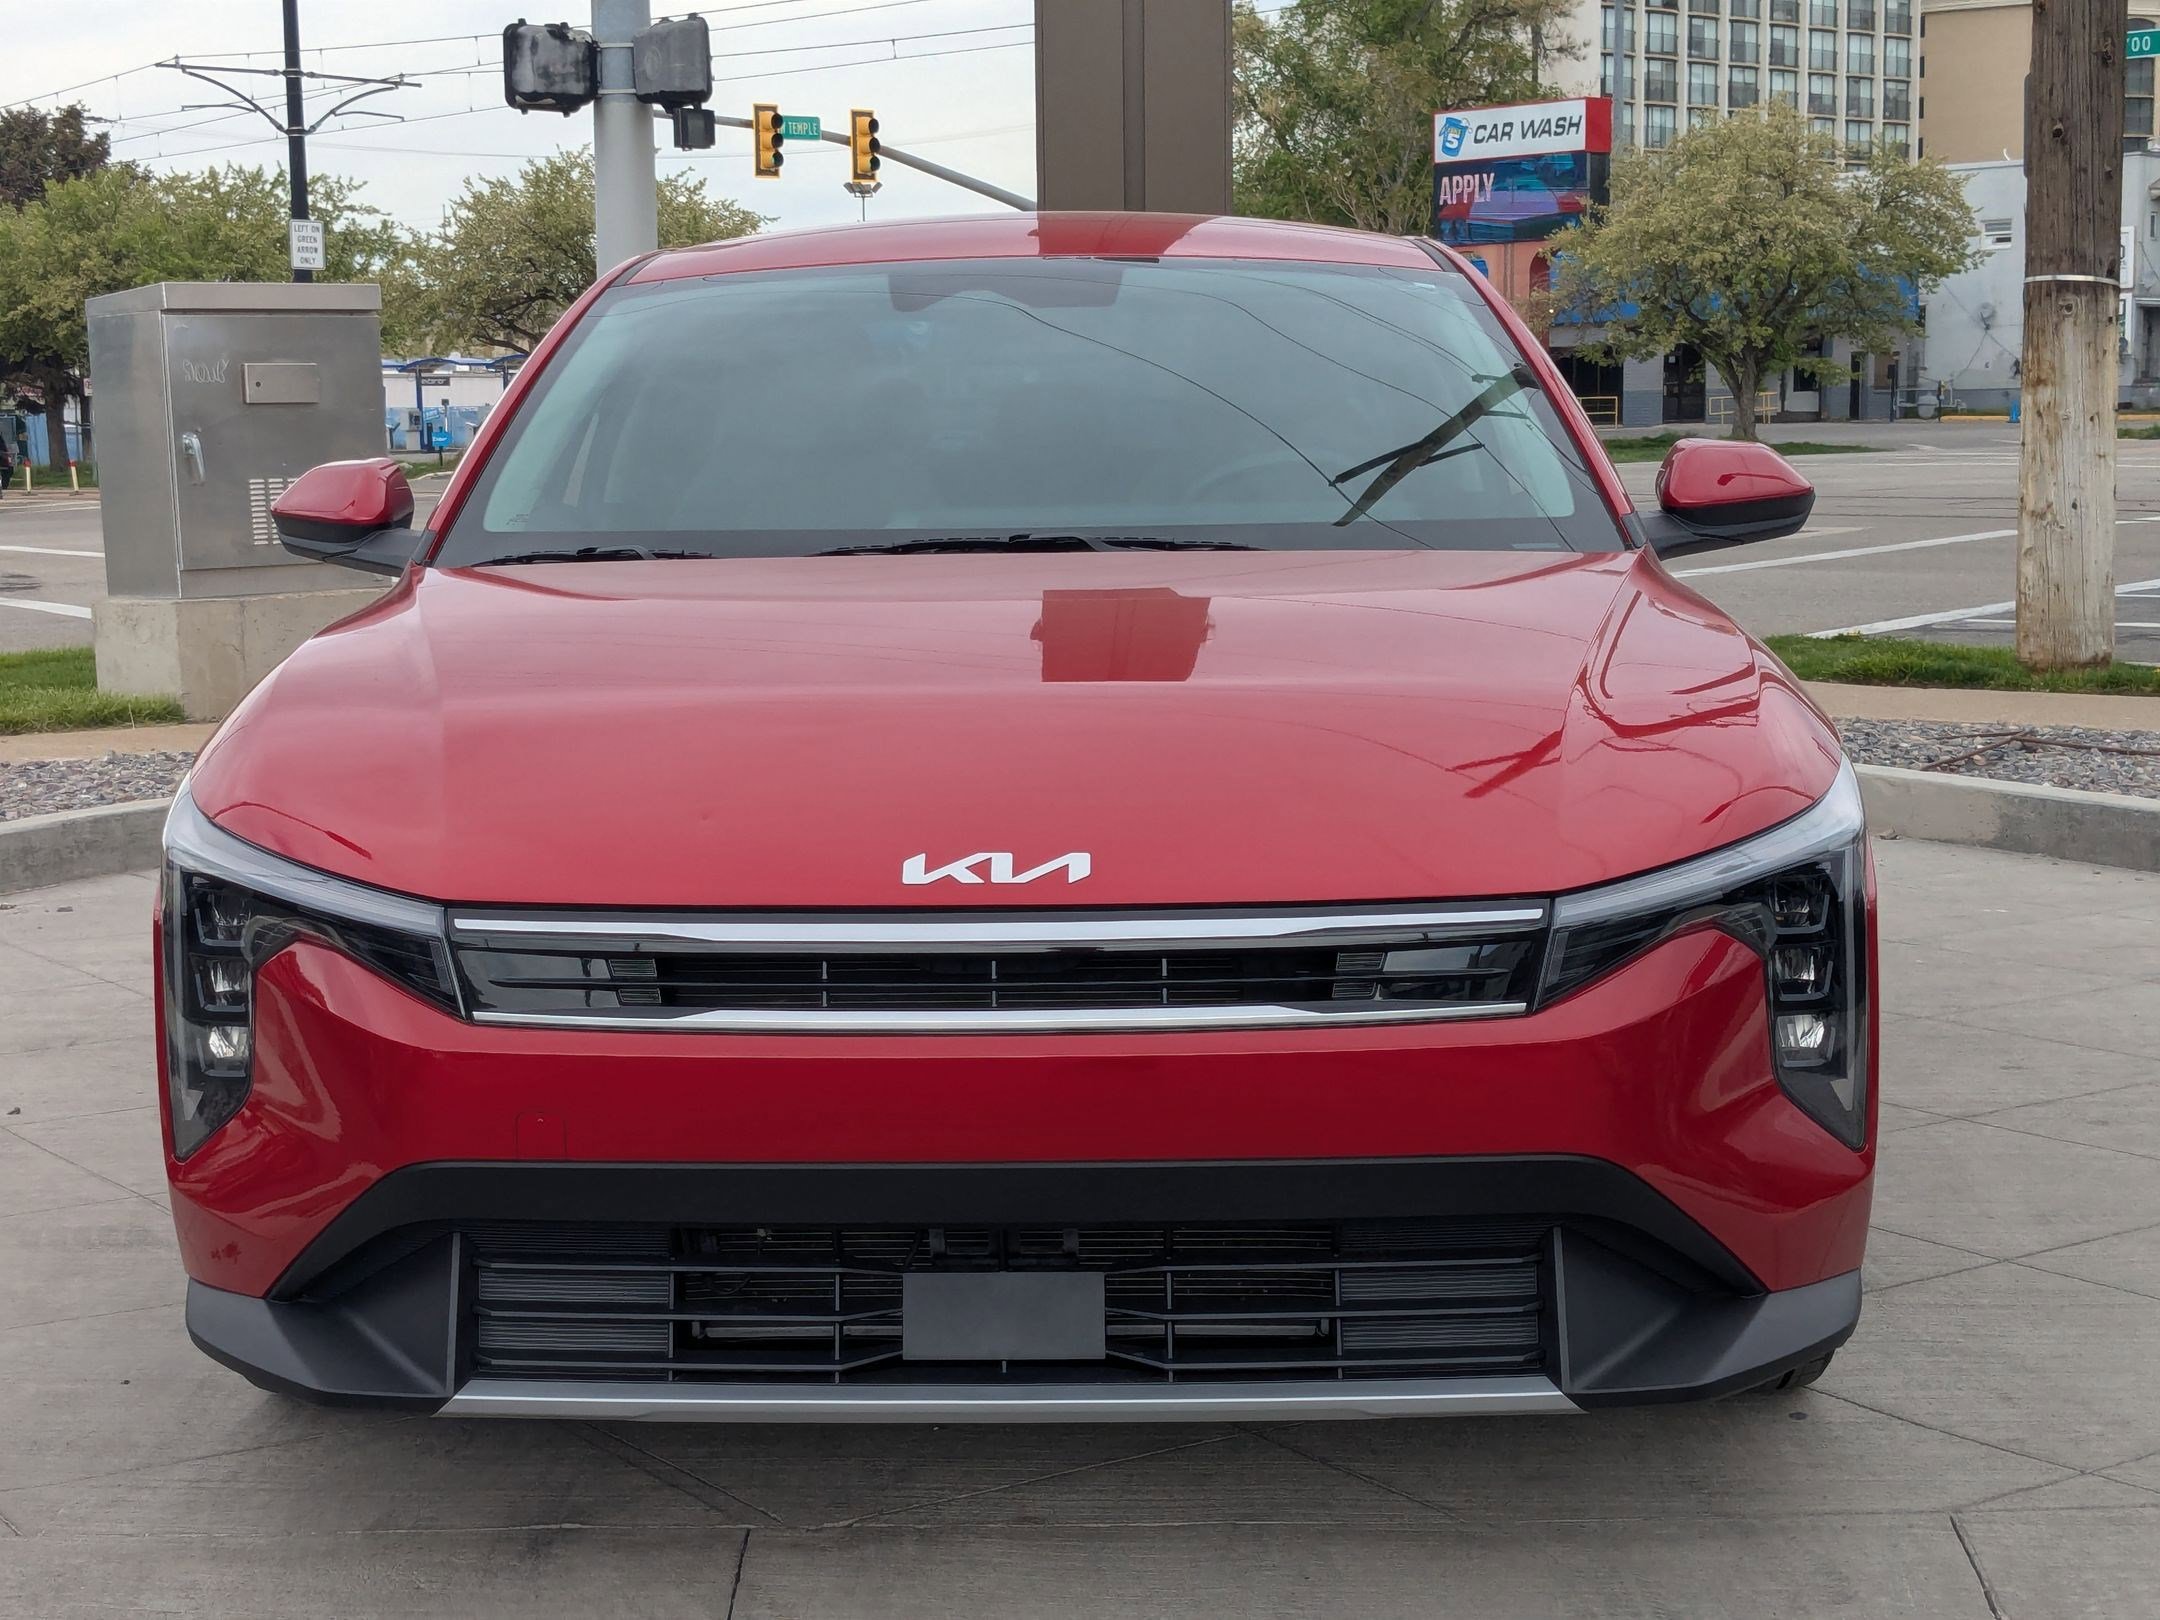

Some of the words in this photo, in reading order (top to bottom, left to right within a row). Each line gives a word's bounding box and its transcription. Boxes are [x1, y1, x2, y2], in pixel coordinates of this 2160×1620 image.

[2127, 36, 2151, 52] 00
[788, 122, 819, 135] TEMPLE
[1473, 121, 1514, 144] CAR
[1520, 115, 1583, 140] WASH
[1445, 133, 1460, 149] 5
[1439, 172, 1496, 206] APPLY
[297, 246, 318, 254] ARROW
[902, 852, 1091, 884] KIA
